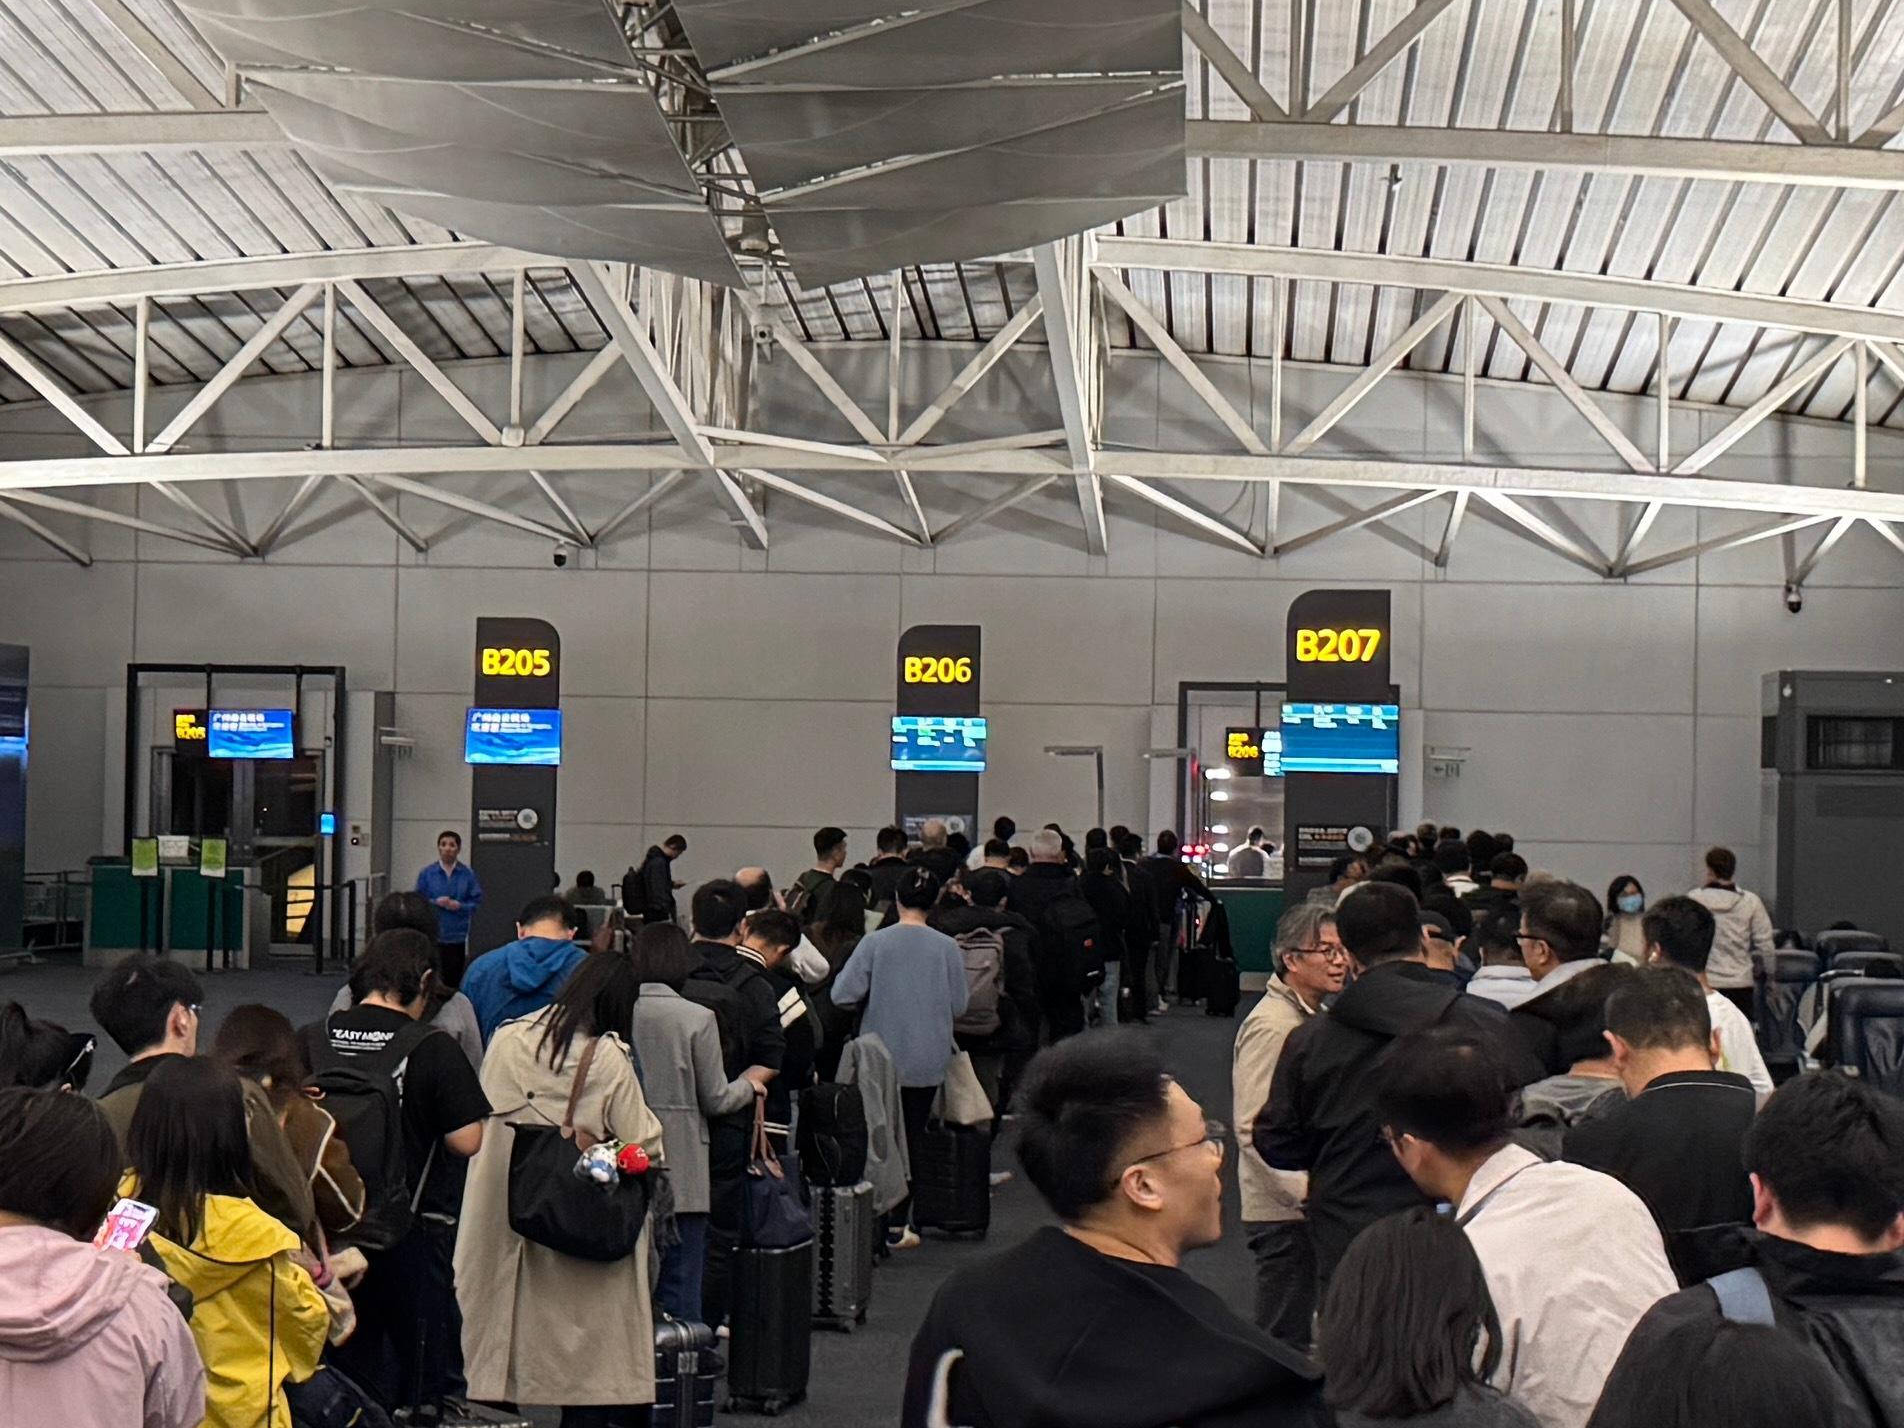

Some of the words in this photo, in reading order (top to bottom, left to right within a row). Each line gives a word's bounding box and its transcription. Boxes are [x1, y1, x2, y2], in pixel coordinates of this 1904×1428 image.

[1296, 629, 1381, 662] B207
[482, 648, 551, 676] B205
[904, 657, 972, 683] B206
